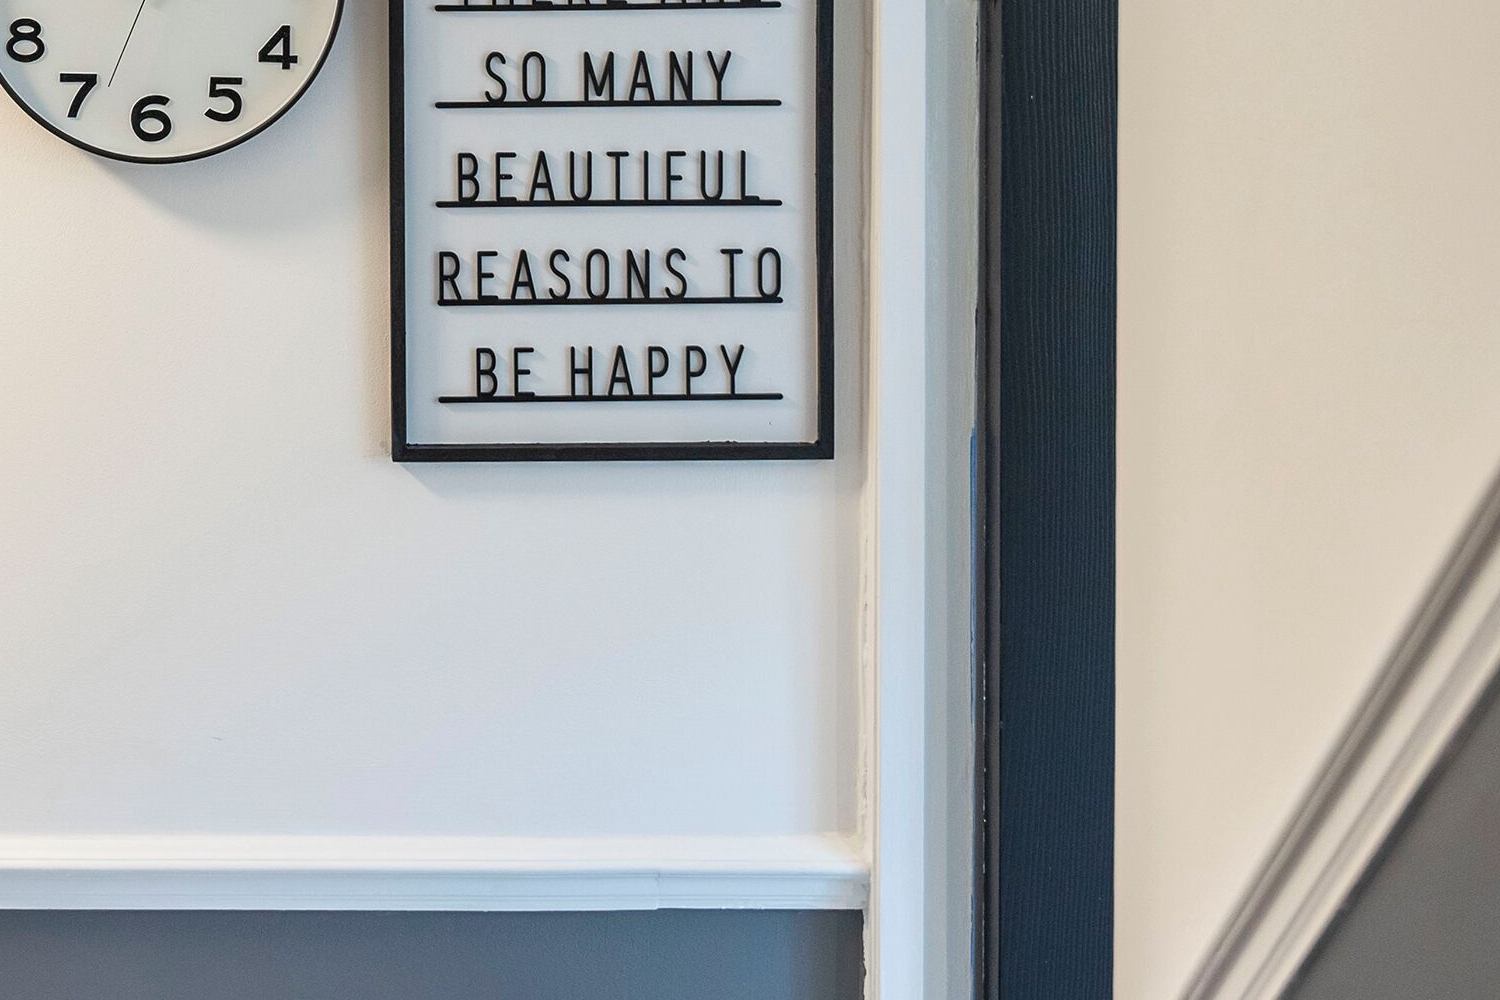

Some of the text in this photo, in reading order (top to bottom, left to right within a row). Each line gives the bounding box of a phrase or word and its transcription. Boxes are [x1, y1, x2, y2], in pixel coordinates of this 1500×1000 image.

[6, 18, 45, 63] 8
[258, 25, 298, 70] 4
[59, 73, 98, 118] 7
[204, 76, 243, 122] 5
[484, 50, 732, 103] SO MANY
[130, 95, 172, 142] 6
[457, 150, 760, 202] BEAUTIFUL
[438, 247, 782, 300] REASONS TO
[475, 344, 745, 398] BE HAPPY
